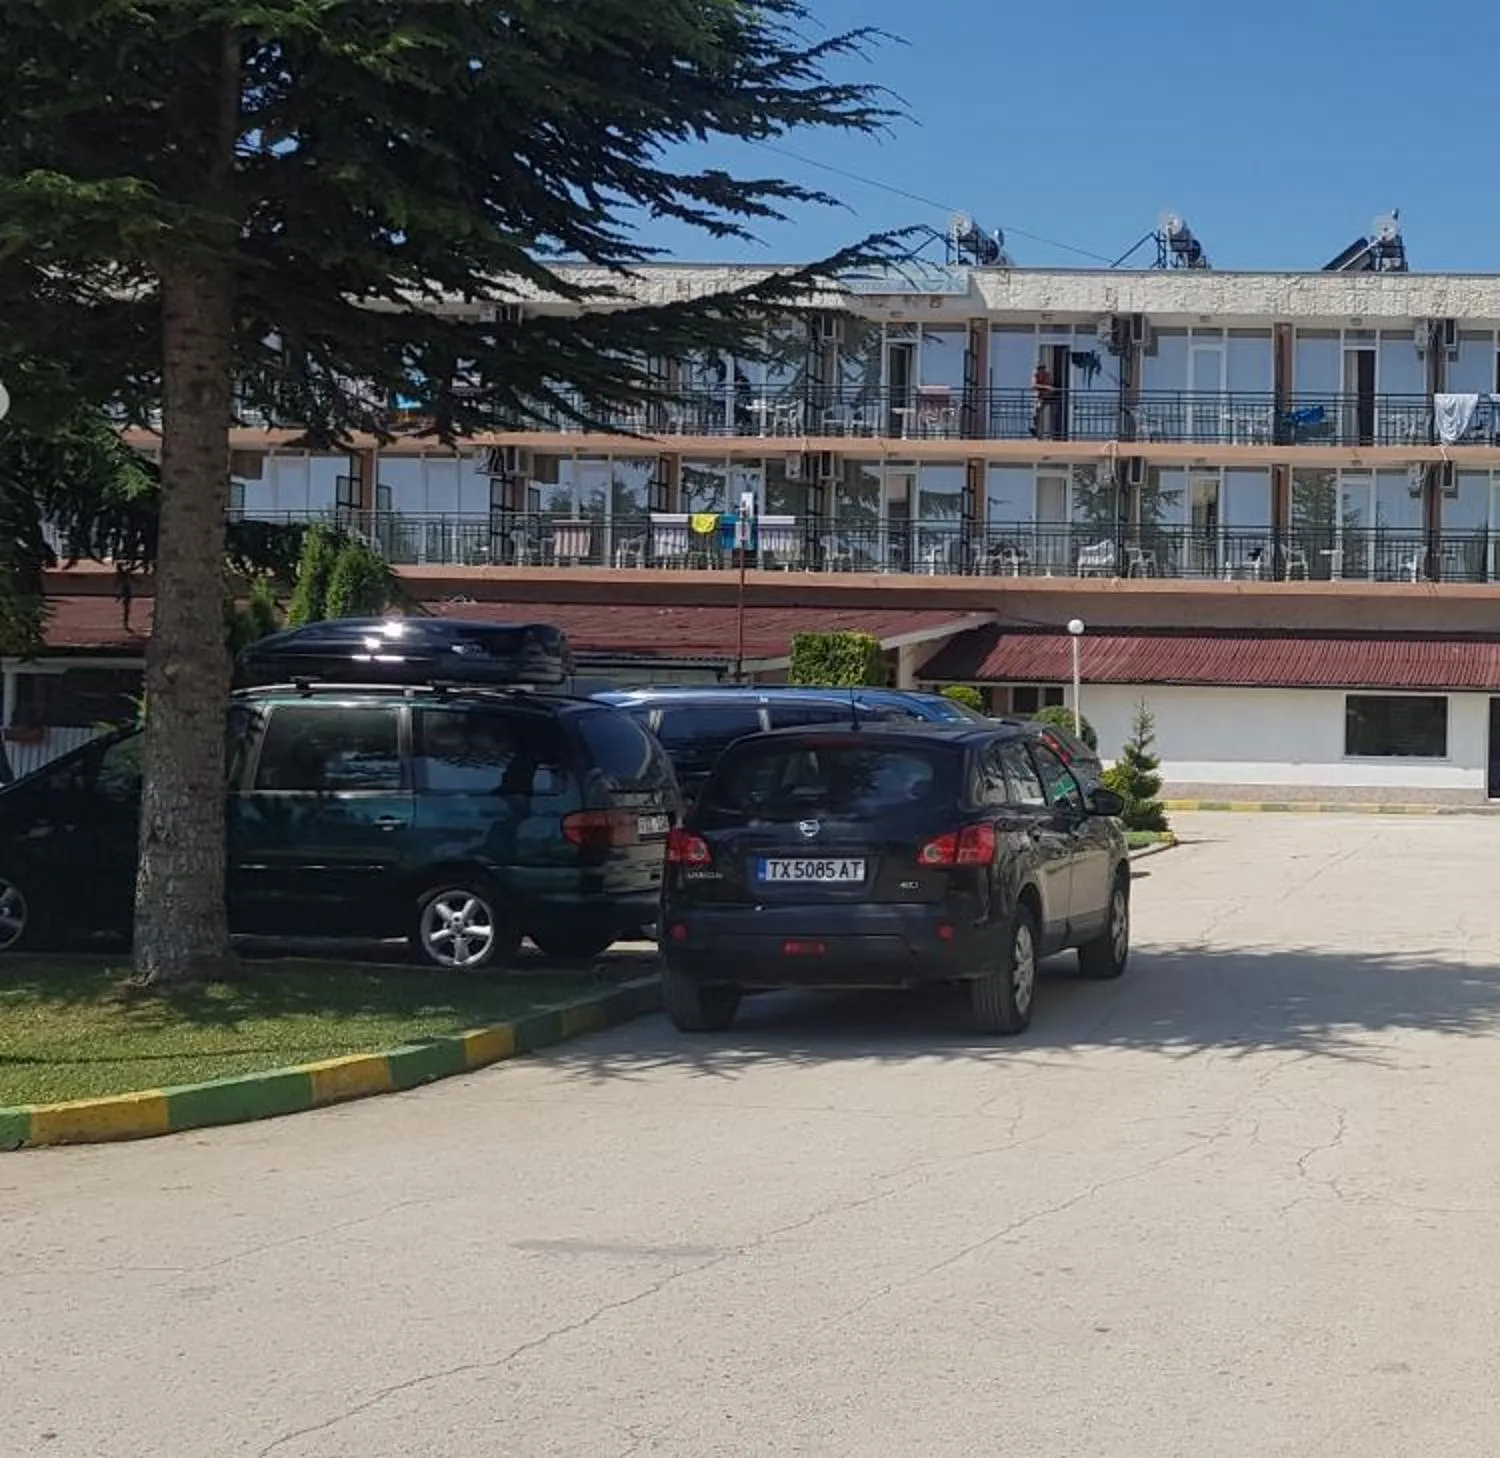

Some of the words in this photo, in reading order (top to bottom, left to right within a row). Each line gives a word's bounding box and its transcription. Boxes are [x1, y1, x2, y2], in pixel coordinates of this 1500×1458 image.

[770, 861, 790, 878] TX
[797, 861, 835, 878] 5085
[838, 861, 862, 878] AT
